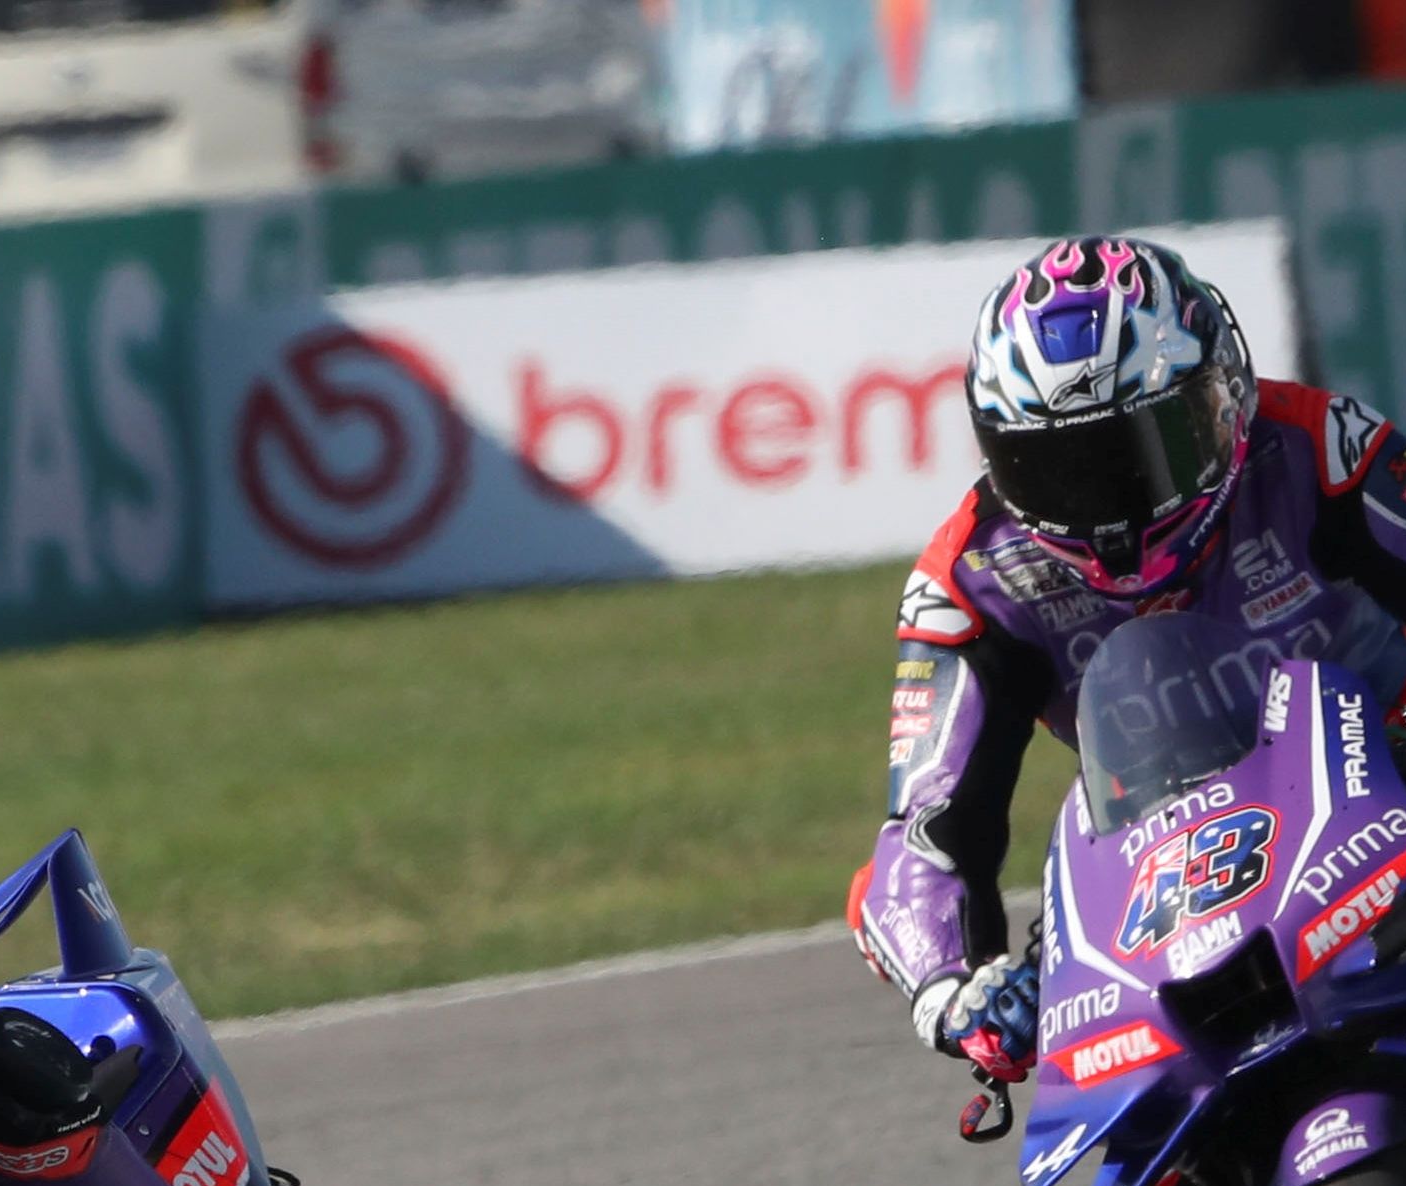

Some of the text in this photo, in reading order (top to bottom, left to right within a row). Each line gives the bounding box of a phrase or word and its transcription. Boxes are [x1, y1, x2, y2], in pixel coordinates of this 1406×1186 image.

[517, 355, 973, 503] brem
[1066, 407, 1117, 427] PRAMAC
[1232, 527, 1287, 579] 21
[1264, 667, 1293, 732] WRS
[1338, 692, 1370, 798] PRAMAC
[1119, 782, 1236, 867] prima
[1116, 806, 1279, 956] 43
[1167, 911, 1243, 977] FIAMM
[1040, 983, 1122, 1053] prima
[1073, 1025, 1159, 1082] MOTUL
[1296, 1134, 1369, 1177] YAMAHA
